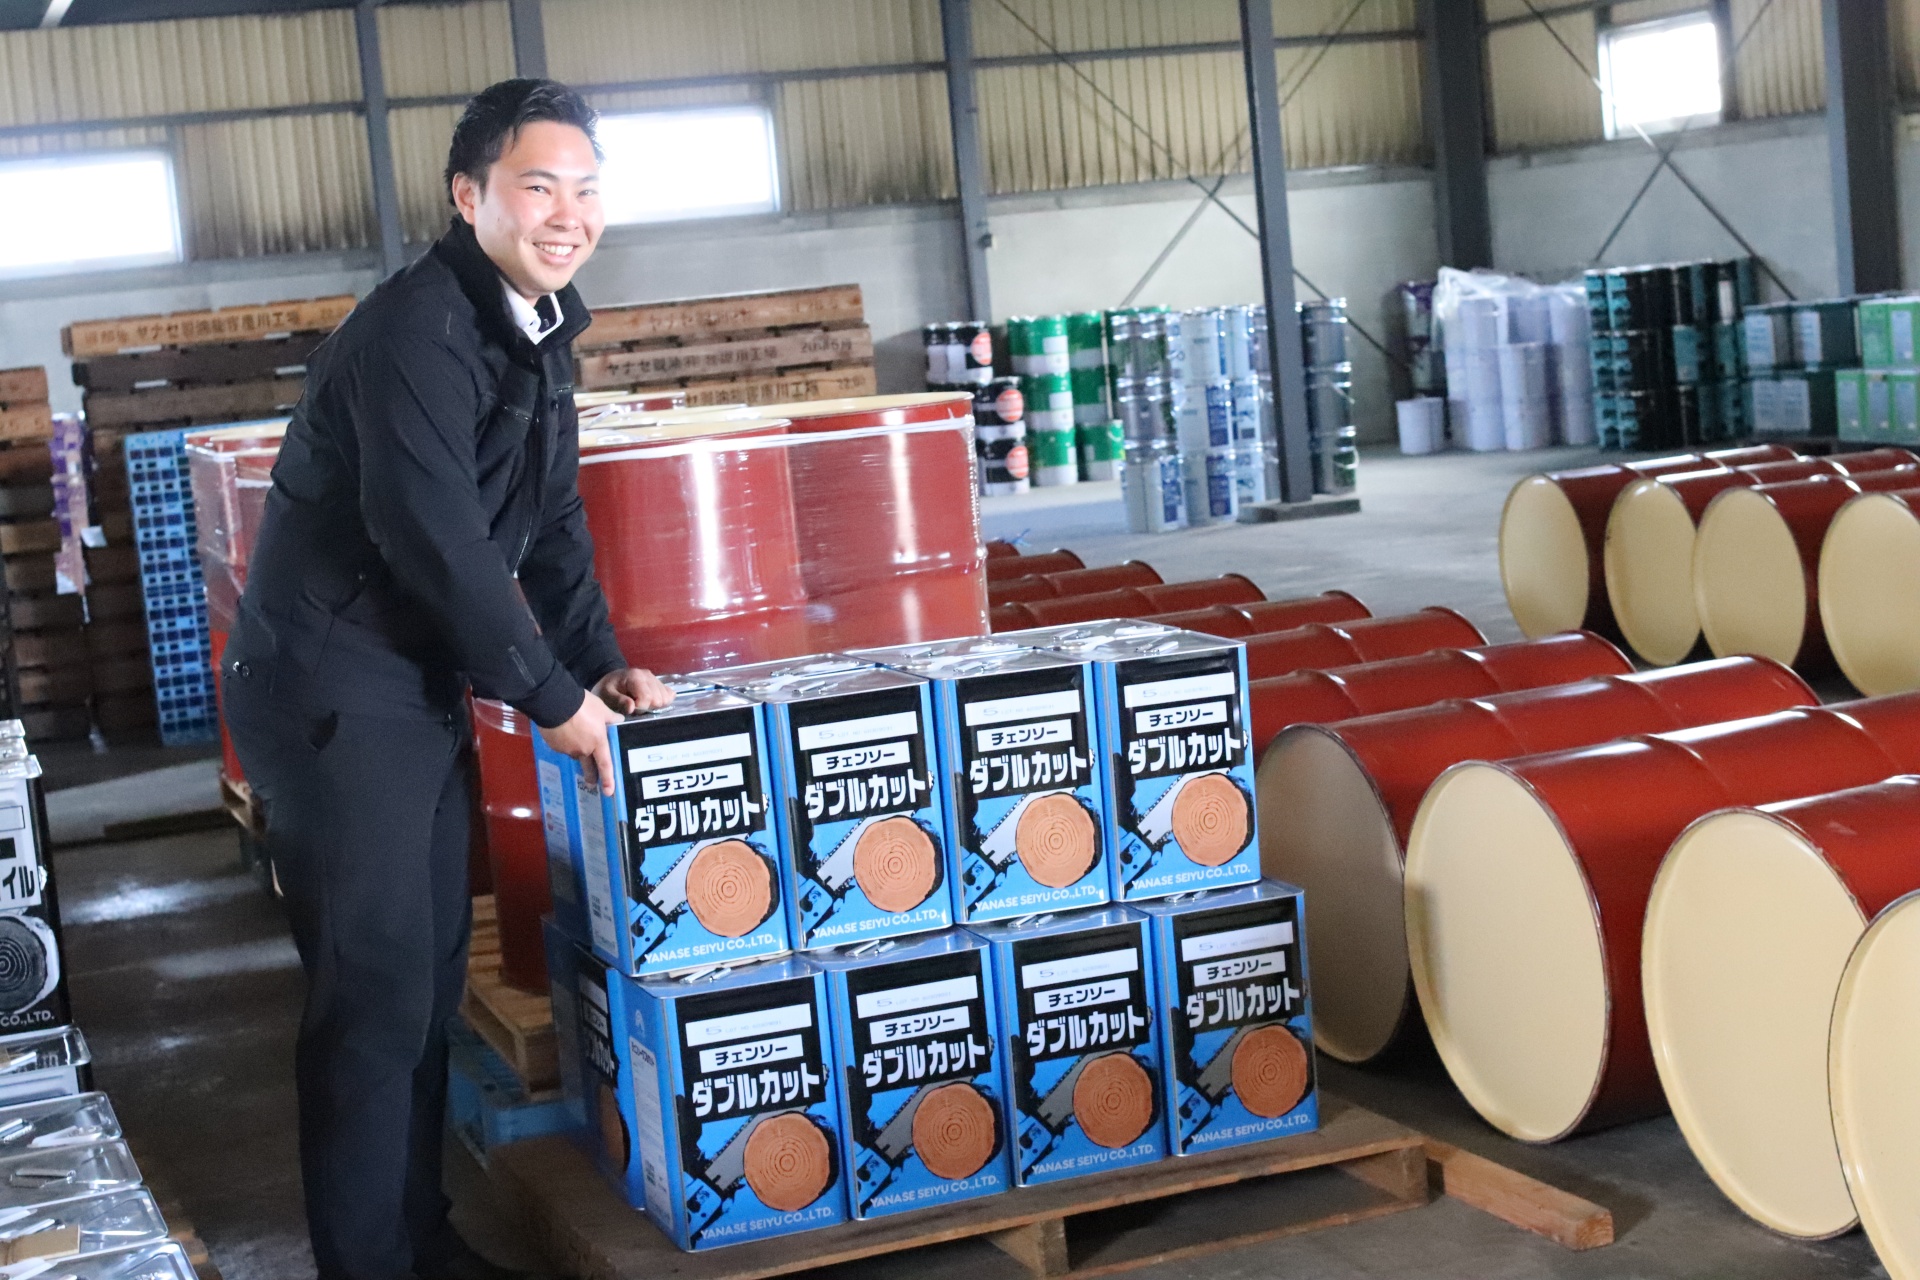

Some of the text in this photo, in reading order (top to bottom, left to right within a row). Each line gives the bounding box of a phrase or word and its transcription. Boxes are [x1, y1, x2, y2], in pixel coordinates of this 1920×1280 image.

[1142, 688, 1158, 698] 5
[983, 707, 998, 716] 5
[1150, 708, 1214, 728] チェンソー
[819, 730, 835, 740] 5
[992, 727, 1058, 746] チェンソー
[647, 752, 664, 762] 5
[826, 749, 896, 770] チェンソー
[1129, 729, 1240, 774] ダブルカット
[970, 746, 1086, 794] ダブルカット
[657, 771, 728, 793] チェンソー
[805, 768, 925, 819] ダブルカット
[635, 791, 759, 843] ダブルカット
[1132, 876, 1172, 890] YANASE
[1176, 870, 1205, 884] SEIYU
[976, 898, 1018, 912] YANASE
[1020, 893, 1050, 906] SEIYU
[813, 923, 857, 939] YANASE
[860, 916, 891, 932] SEIYU
[645, 947, 691, 964] YANASE
[693, 942, 724, 956] SEIYU
[1198, 942, 1214, 952] 5
[1040, 969, 1054, 978] 5
[1207, 959, 1272, 978] チェンソー
[876, 998, 892, 1008] 5
[1048, 986, 1116, 1008] チェンソー
[1186, 978, 1300, 1028] ダブルカット
[706, 1026, 722, 1035] 5
[886, 1014, 954, 1037] チェンソー
[1026, 1006, 1144, 1057] ダブルカット
[716, 1044, 788, 1064] チェンソー
[862, 1034, 986, 1088] ダブルカット
[692, 1063, 820, 1118] ダブルカット
[1191, 1129, 1232, 1144] YANASE
[1235, 1123, 1264, 1136] SEIYU
[1032, 1158, 1076, 1175] YANASE
[1078, 1152, 1108, 1166] SEIYU
[870, 1191, 914, 1208] YANASE
[917, 1184, 948, 1198] SEIYU
[701, 1222, 746, 1240] YANASE
[750, 1216, 782, 1230] SEIYU
